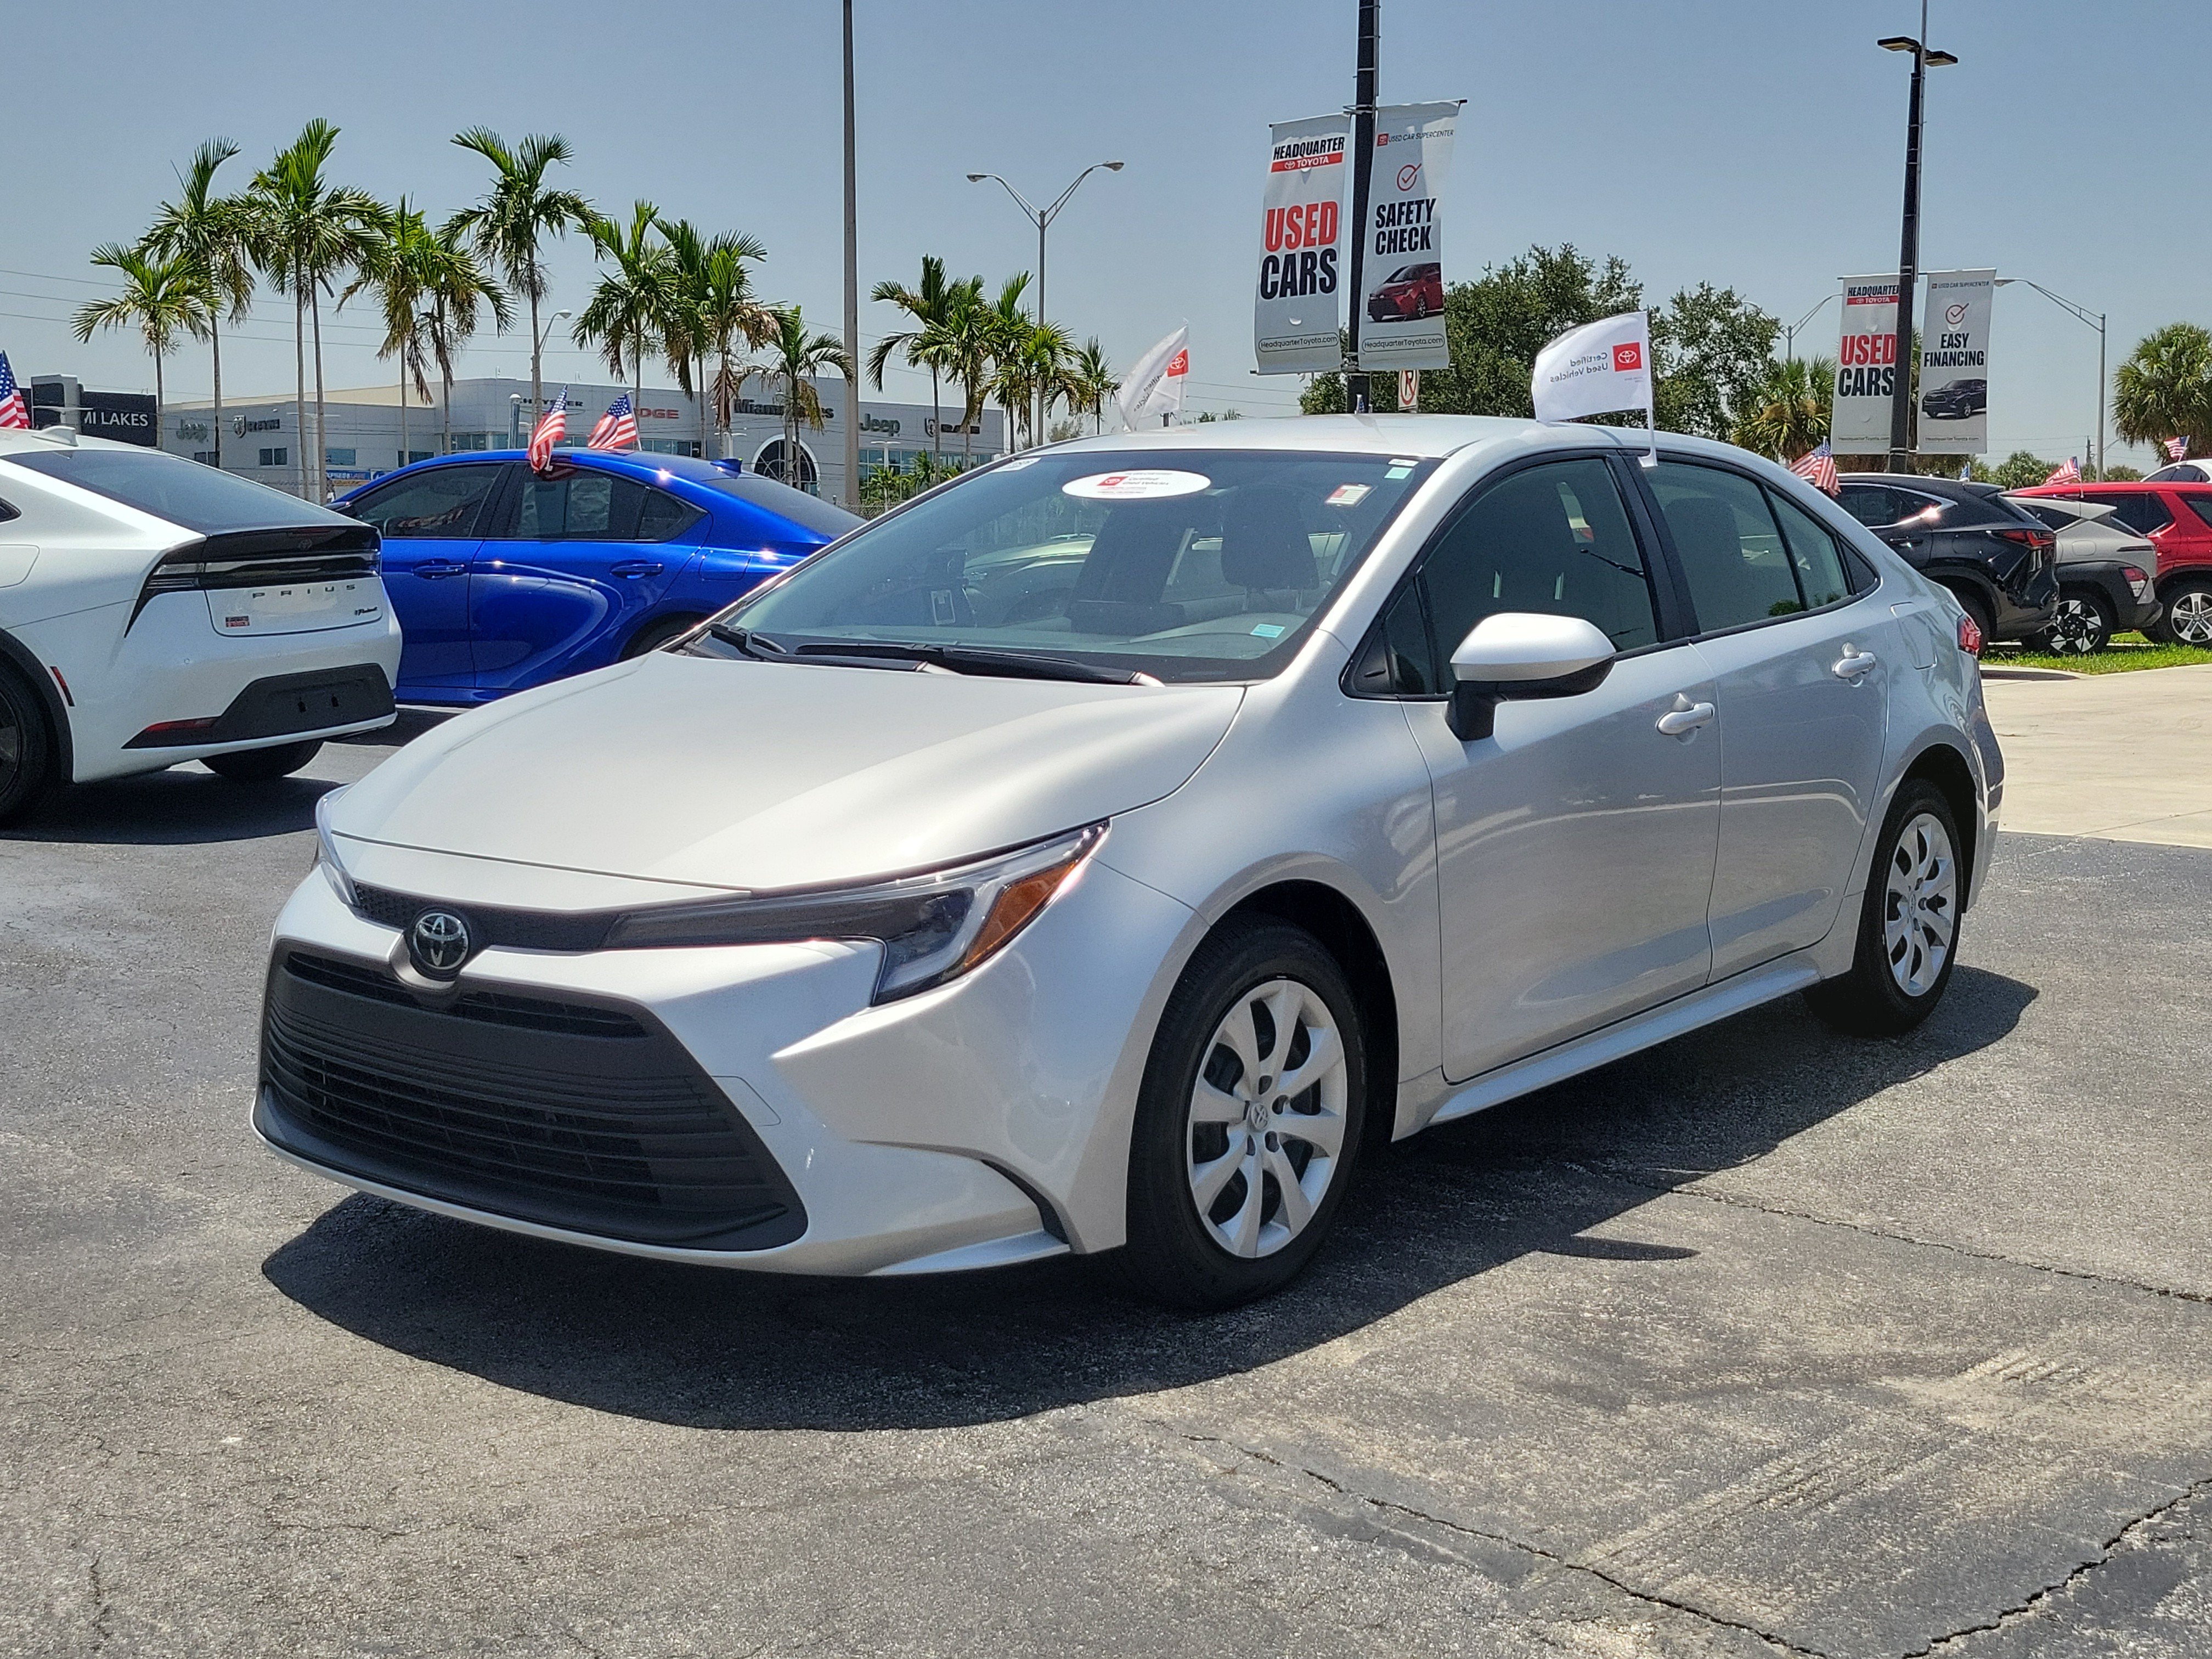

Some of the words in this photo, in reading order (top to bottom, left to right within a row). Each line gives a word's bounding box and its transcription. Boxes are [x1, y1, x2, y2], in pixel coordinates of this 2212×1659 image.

[1415, 129, 1454, 139] SUPERCENTER
[1273, 137, 1345, 161] HEADQUARTER
[1297, 156, 1329, 168] TOYOTA
[1375, 198, 1436, 228] SAFETY
[1265, 201, 1338, 252] USED
[1375, 225, 1431, 255] CHECK
[1260, 248, 1337, 300] CARS
[1261, 336, 1337, 348] HeadquarterToyota.com
[1364, 338, 1443, 348] HeadquarterToyota.com
[1841, 334, 1897, 365] USED
[1940, 332, 1969, 348] EASY
[1924, 350, 1984, 367] FINANCING
[1838, 366, 1894, 397] CARS
[101, 412, 148, 426] LAKES
[859, 413, 900, 437] Jeep
[252, 584, 356, 599] PRIUS
